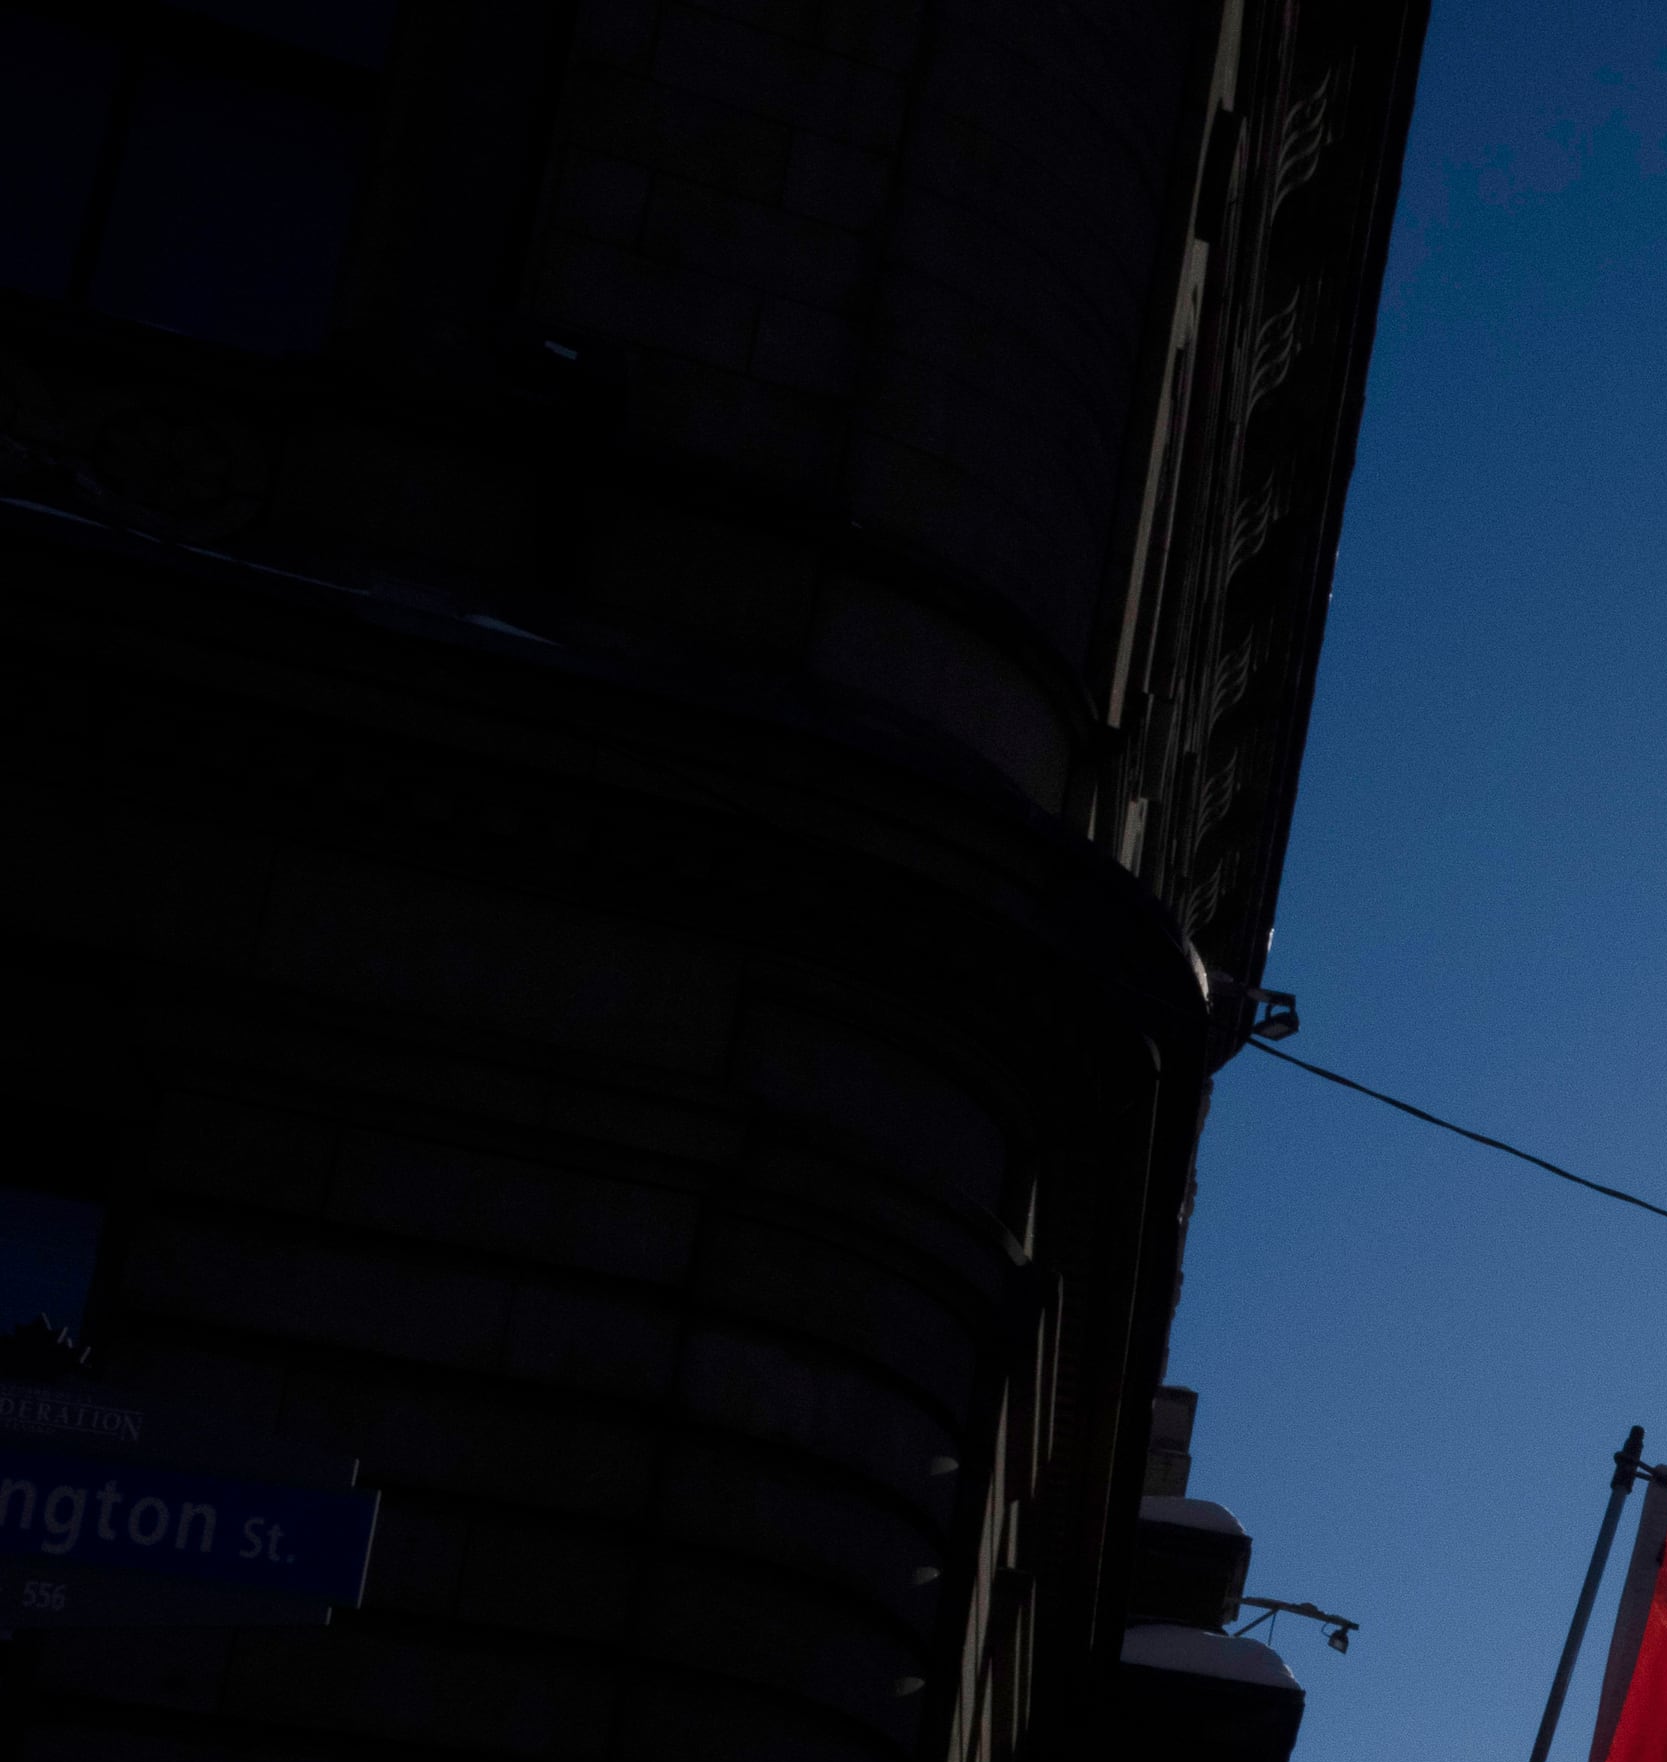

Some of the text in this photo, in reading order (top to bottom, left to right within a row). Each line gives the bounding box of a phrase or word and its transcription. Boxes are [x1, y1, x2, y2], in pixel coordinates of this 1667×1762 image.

[0, 1477, 297, 1564] ngton St.
[22, 1581, 66, 1612] 556
